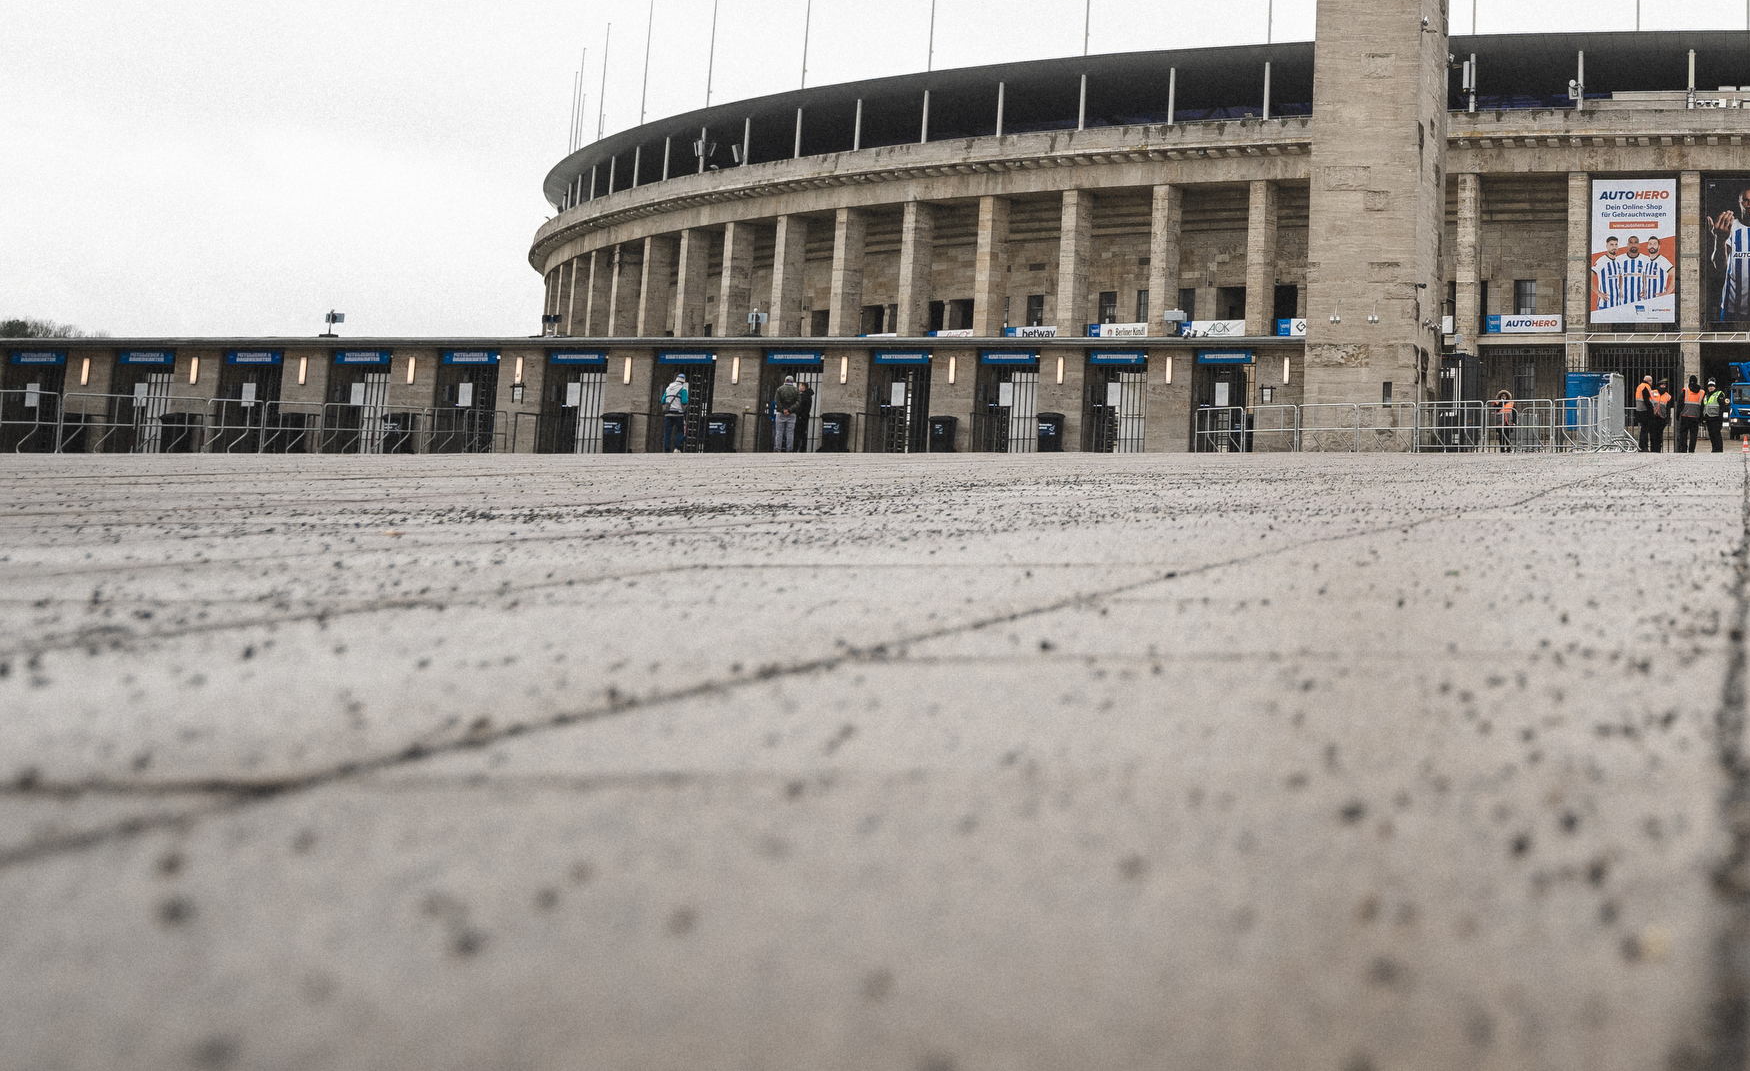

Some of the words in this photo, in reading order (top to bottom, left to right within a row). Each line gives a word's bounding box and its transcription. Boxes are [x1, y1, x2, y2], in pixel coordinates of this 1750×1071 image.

[1599, 190, 1669, 200] AUTOHERO
[1116, 328, 1132, 336] Berliner
[1207, 322, 1231, 332] AOK
